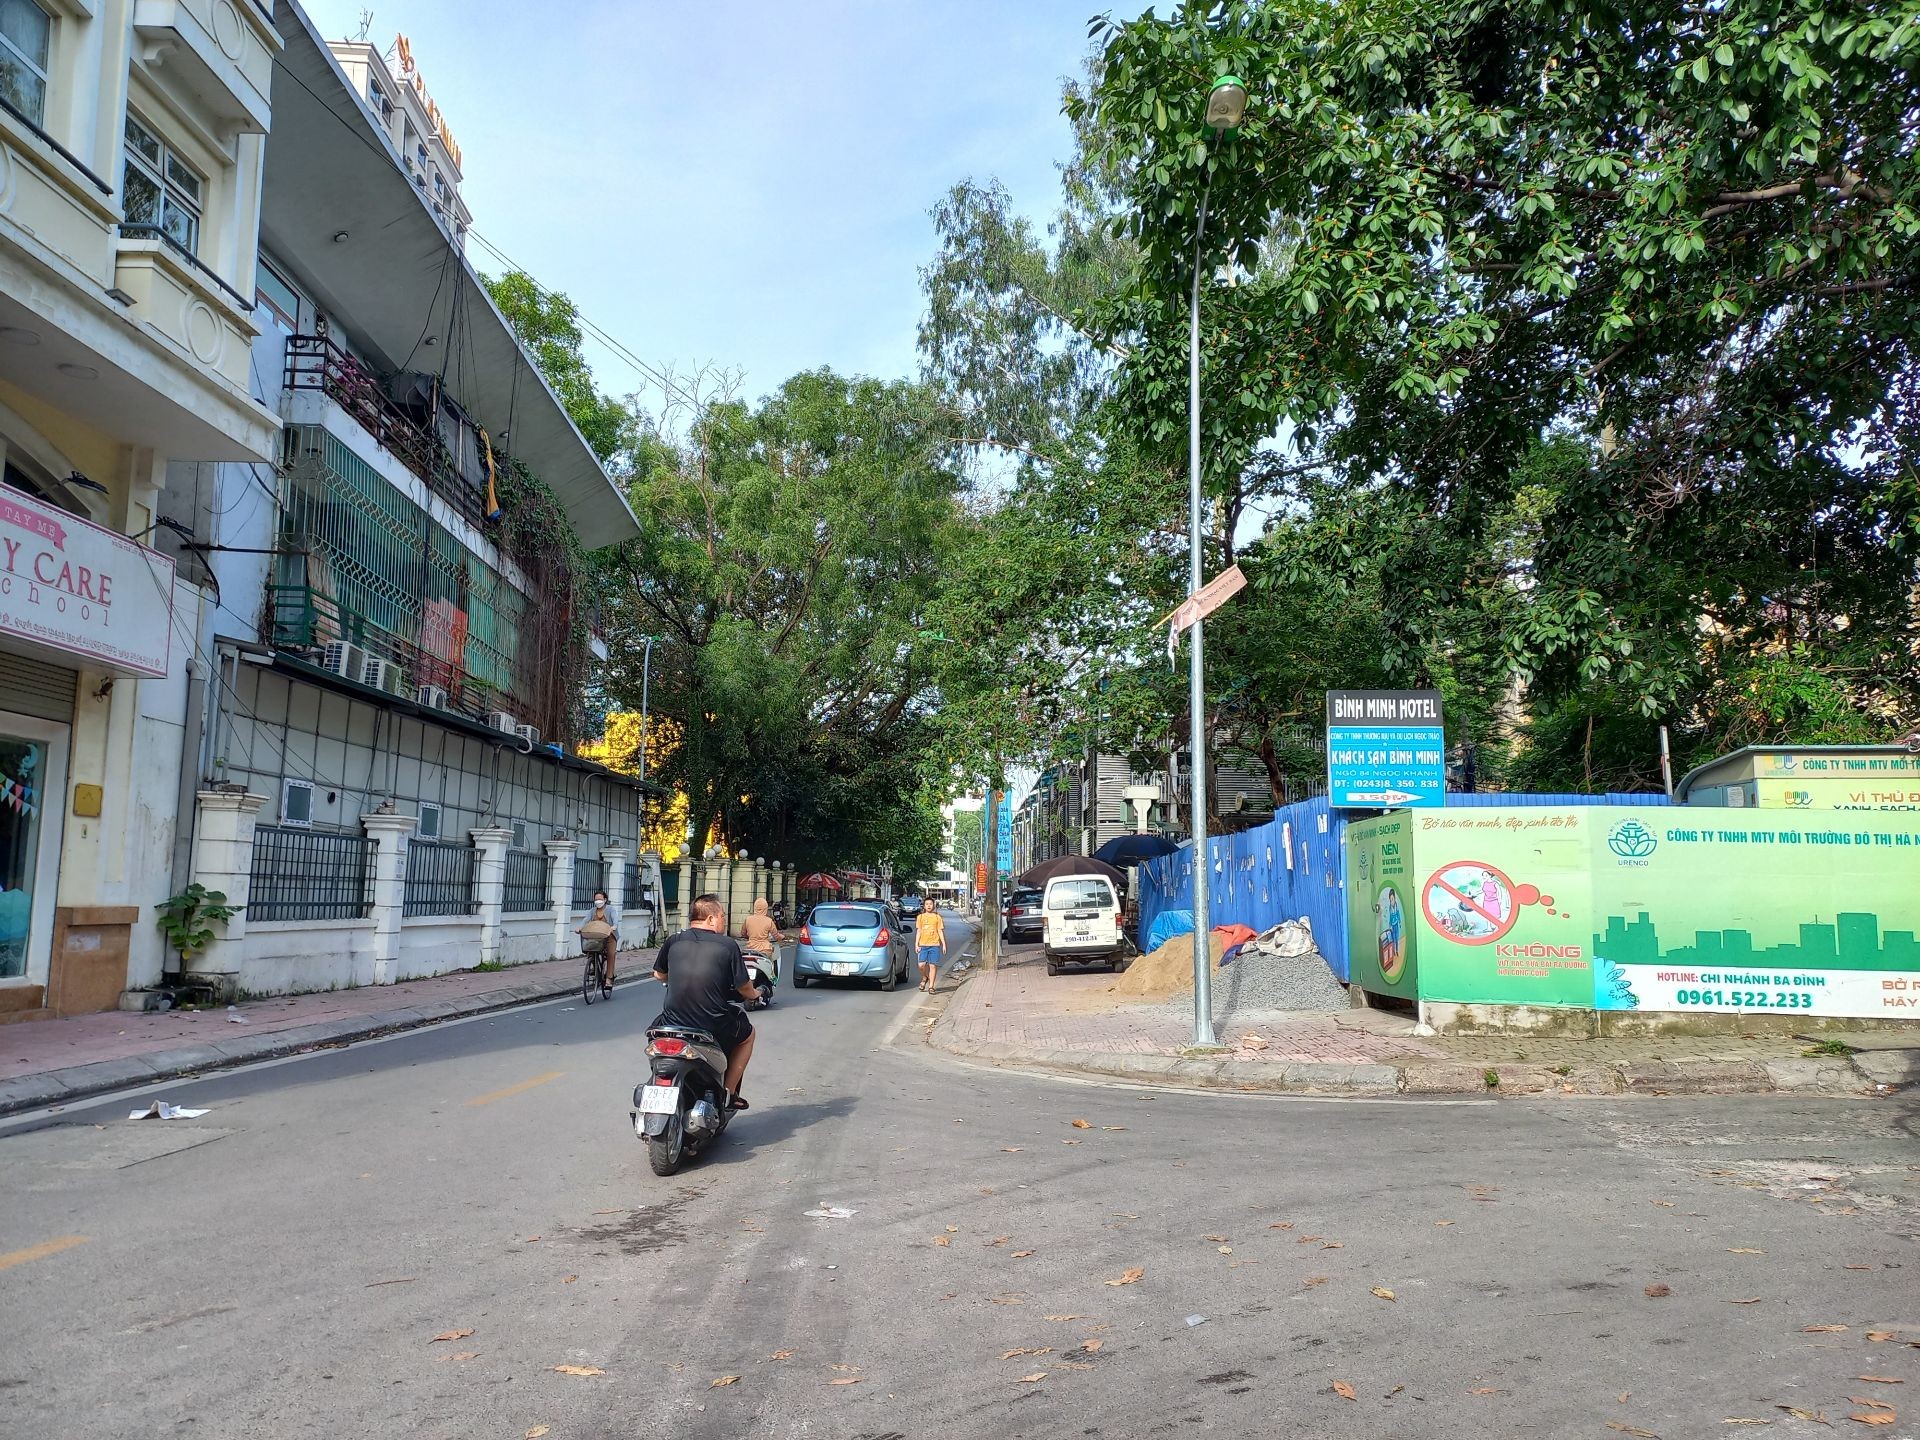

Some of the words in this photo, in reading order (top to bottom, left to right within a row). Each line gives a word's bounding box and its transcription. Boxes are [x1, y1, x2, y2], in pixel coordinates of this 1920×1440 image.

[5, 507, 31, 525] TAY
[34, 552, 113, 606] CARE
[1335, 695, 1363, 720] BÌNH
[1367, 699, 1396, 720] MINH
[1400, 698, 1436, 720] HOTEL
[1332, 747, 1364, 765] KHÁCH
[1367, 750, 1386, 768] SẠN
[1389, 747, 1412, 766] BÌNH
[1416, 750, 1440, 766] MINH
[1803, 757, 1827, 770] CÔNG
[1830, 760, 1840, 770] TY
[1843, 760, 1866, 770] TNHH
[1869, 760, 1887, 770] MTV
[1891, 757, 1908, 770] MÔI
[1849, 791, 1865, 803] VÌ
[1871, 790, 1903, 803] THỦ
[1667, 828, 1697, 842] CÔNG
[1701, 831, 1714, 842] TY
[1717, 831, 1747, 843] TNHH
[1751, 831, 1775, 843] MTV
[1779, 830, 1801, 844] MÔI
[1804, 829, 1851, 845] TRƯỜNG
[1855, 831, 1870, 845] ĐÔ
[1873, 833, 1892, 848] THỊ
[1895, 831, 1911, 846] HÀ
[1381, 840, 1399, 856] NÊN
[1496, 942, 1581, 958] KHÔNG
[1657, 973, 1699, 983] HOTLINE:
[1700, 973, 1721, 984] CHI
[1724, 972, 1770, 985] NHÁNH
[1774, 976, 1790, 986] BA
[1793, 973, 1826, 986] ĐÌNH
[1677, 989, 1812, 1008] 0961.522.233
[1883, 996, 1918, 1007] HÃY
